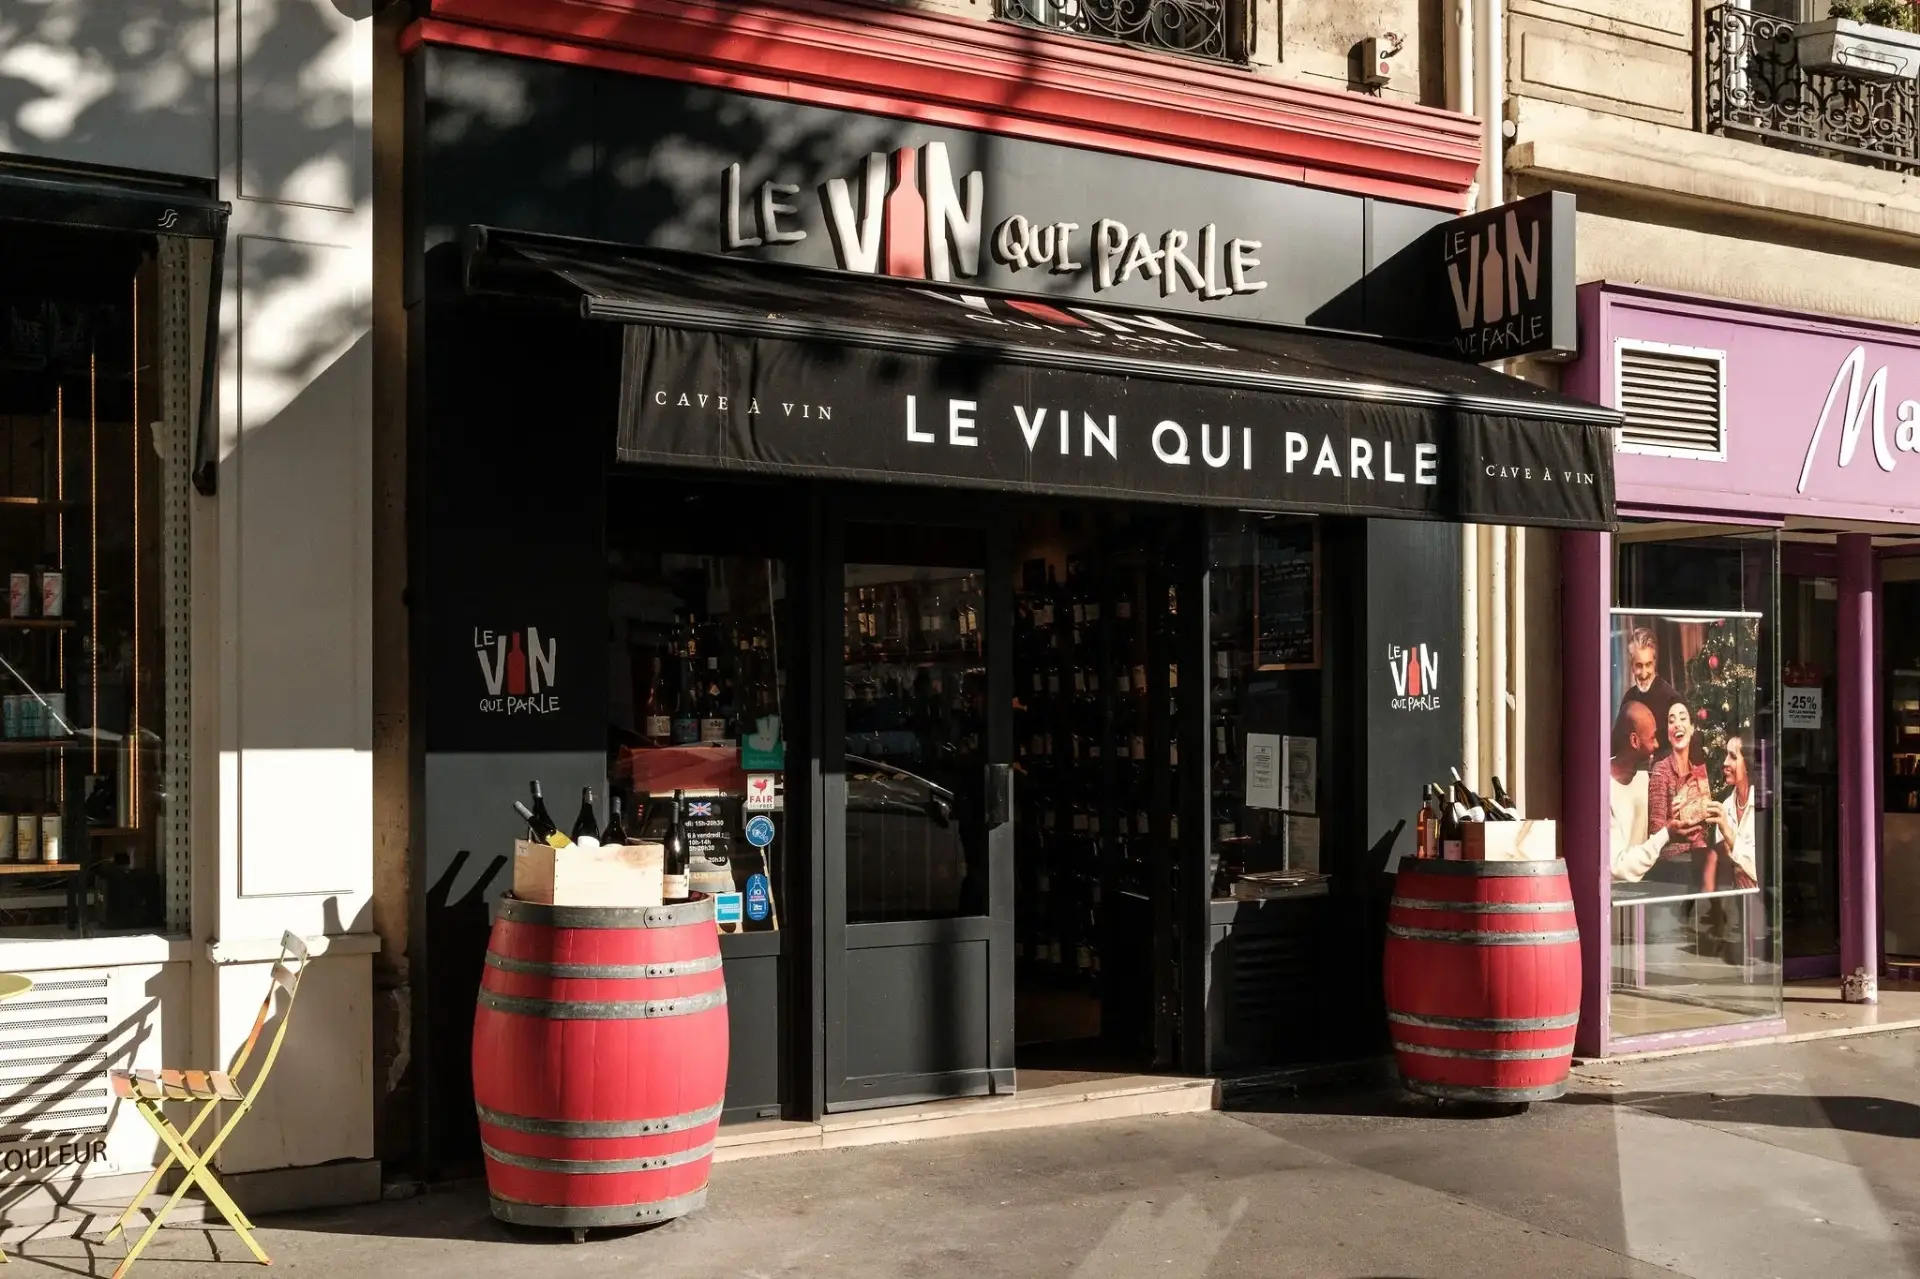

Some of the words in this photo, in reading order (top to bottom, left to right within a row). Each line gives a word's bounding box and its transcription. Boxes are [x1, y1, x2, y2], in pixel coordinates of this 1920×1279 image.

[721, 162, 807, 251] LE
[818, 141, 984, 282] VIN
[991, 214, 1082, 273] QUI
[1091, 218, 1268, 301] PARLE
[1444, 230, 1467, 261] LE
[1448, 209, 1540, 330] VIN
[655, 391, 729, 411] CAVE
[748, 397, 761, 414] À
[782, 402, 832, 421] VIN
[1797, 344, 1920, 494] Ma
[906, 394, 979, 447] LE
[1013, 405, 1118, 461] VIN
[1152, 420, 1252, 470] QUI
[1285, 431, 1438, 486] PARLE
[1485, 464, 1532, 480] CAVE
[1543, 467, 1552, 481] À
[1564, 471, 1595, 485] VIN
[474, 626, 495, 648] LE
[1388, 643, 1402, 660] LE
[477, 626, 556, 695] VIN
[1390, 643, 1439, 697] VIN
[480, 698, 504, 712] QUI
[507, 693, 560, 715] PARLE
[1391, 698, 1407, 709] QUI
[1408, 694, 1441, 712] PARLE
[1787, 695, 1817, 710] -25%
[749, 795, 773, 804] FAIR
[0, 1140, 108, 1172] OULEUR
